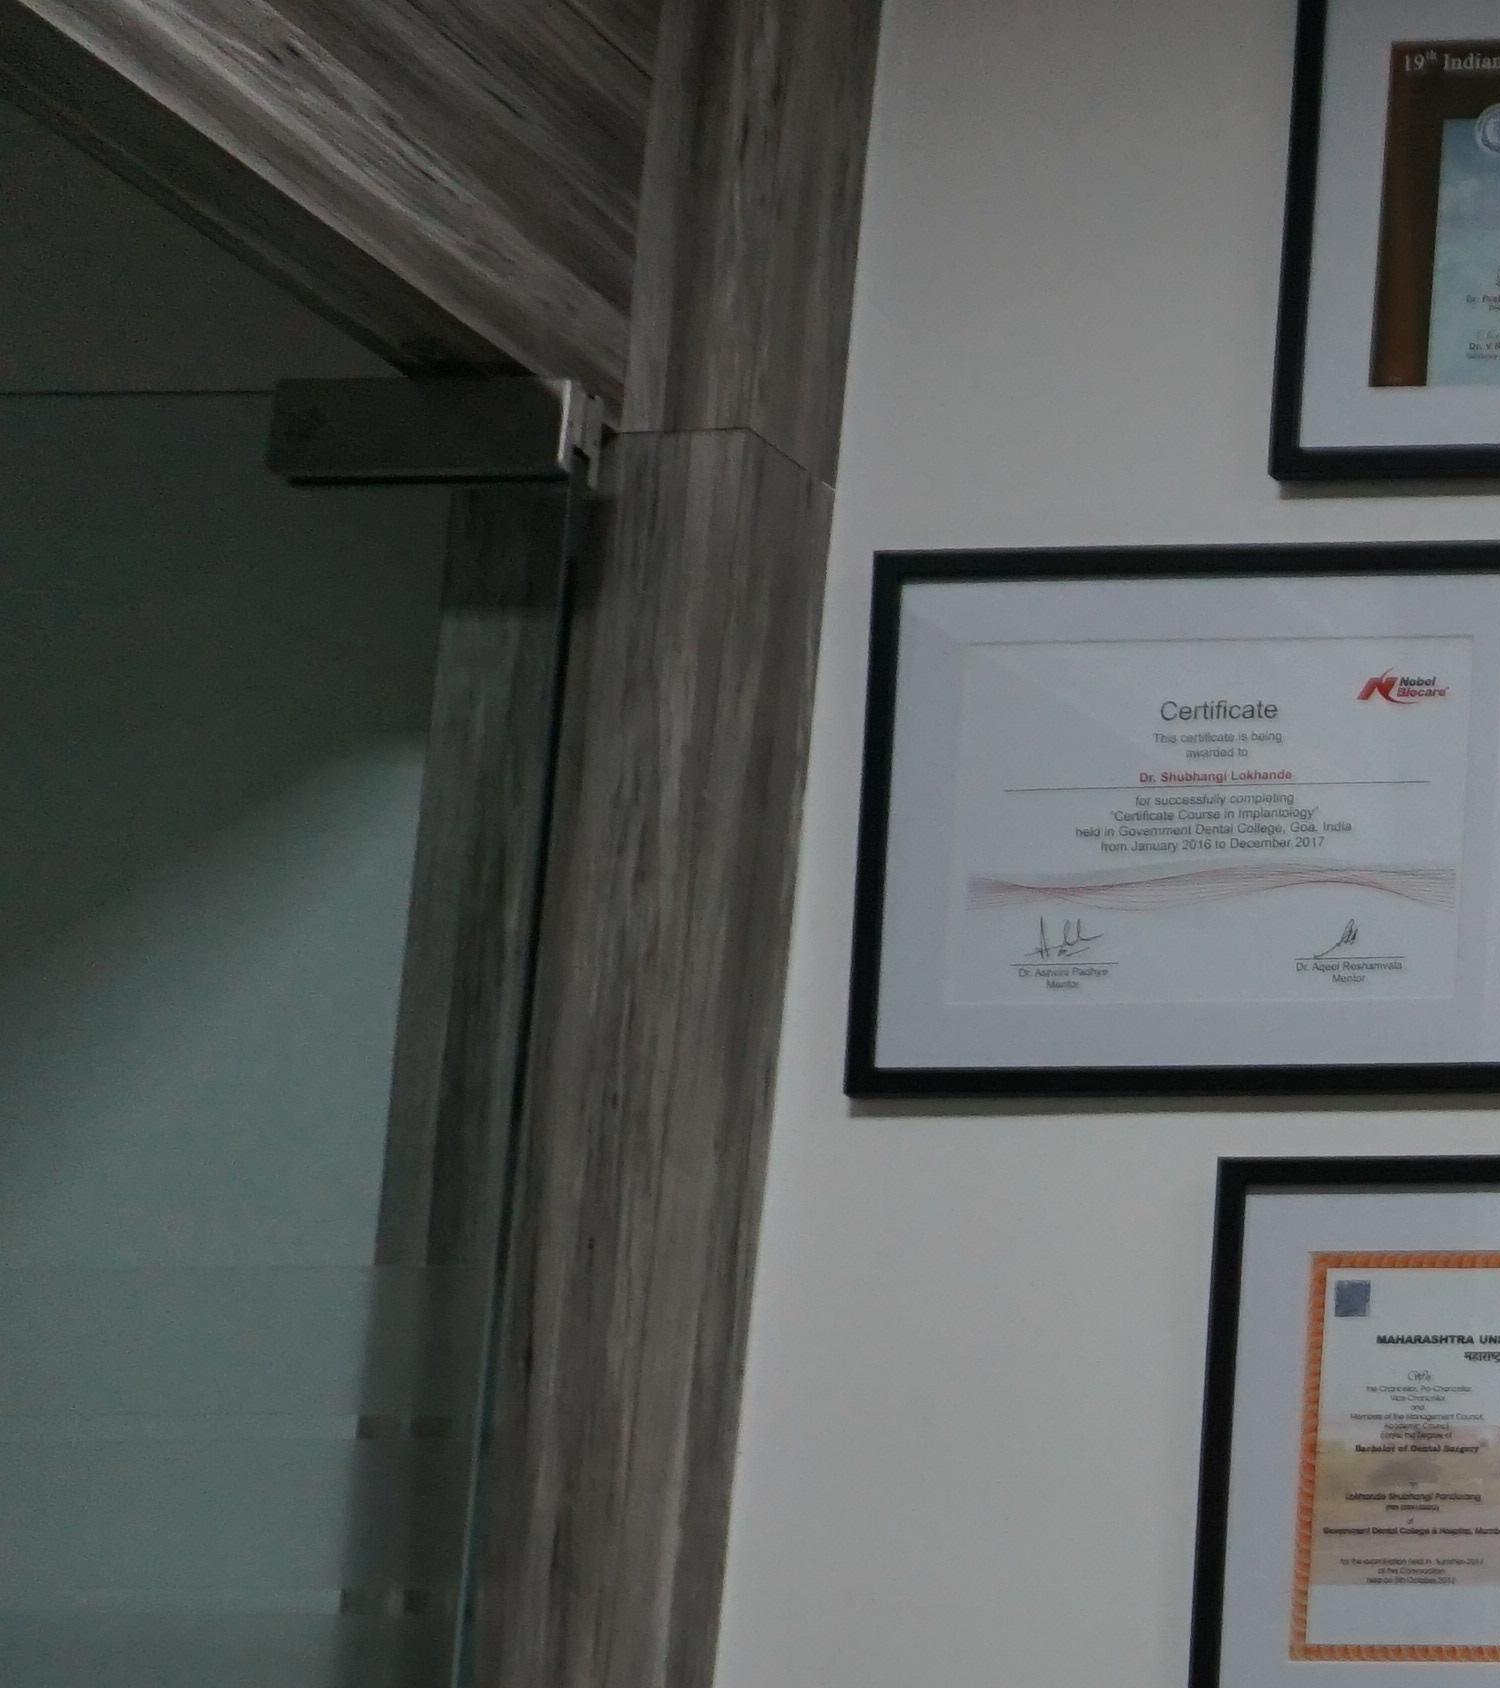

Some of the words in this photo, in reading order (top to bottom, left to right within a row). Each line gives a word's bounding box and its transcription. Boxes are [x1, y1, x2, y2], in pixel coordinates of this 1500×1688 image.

[1404, 49, 1437, 72] 19th
[1399, 676, 1438, 687] Nobel
[1160, 699, 1279, 722] Certificate
[1376, 1334, 1475, 1345] MAHARASHTRA
